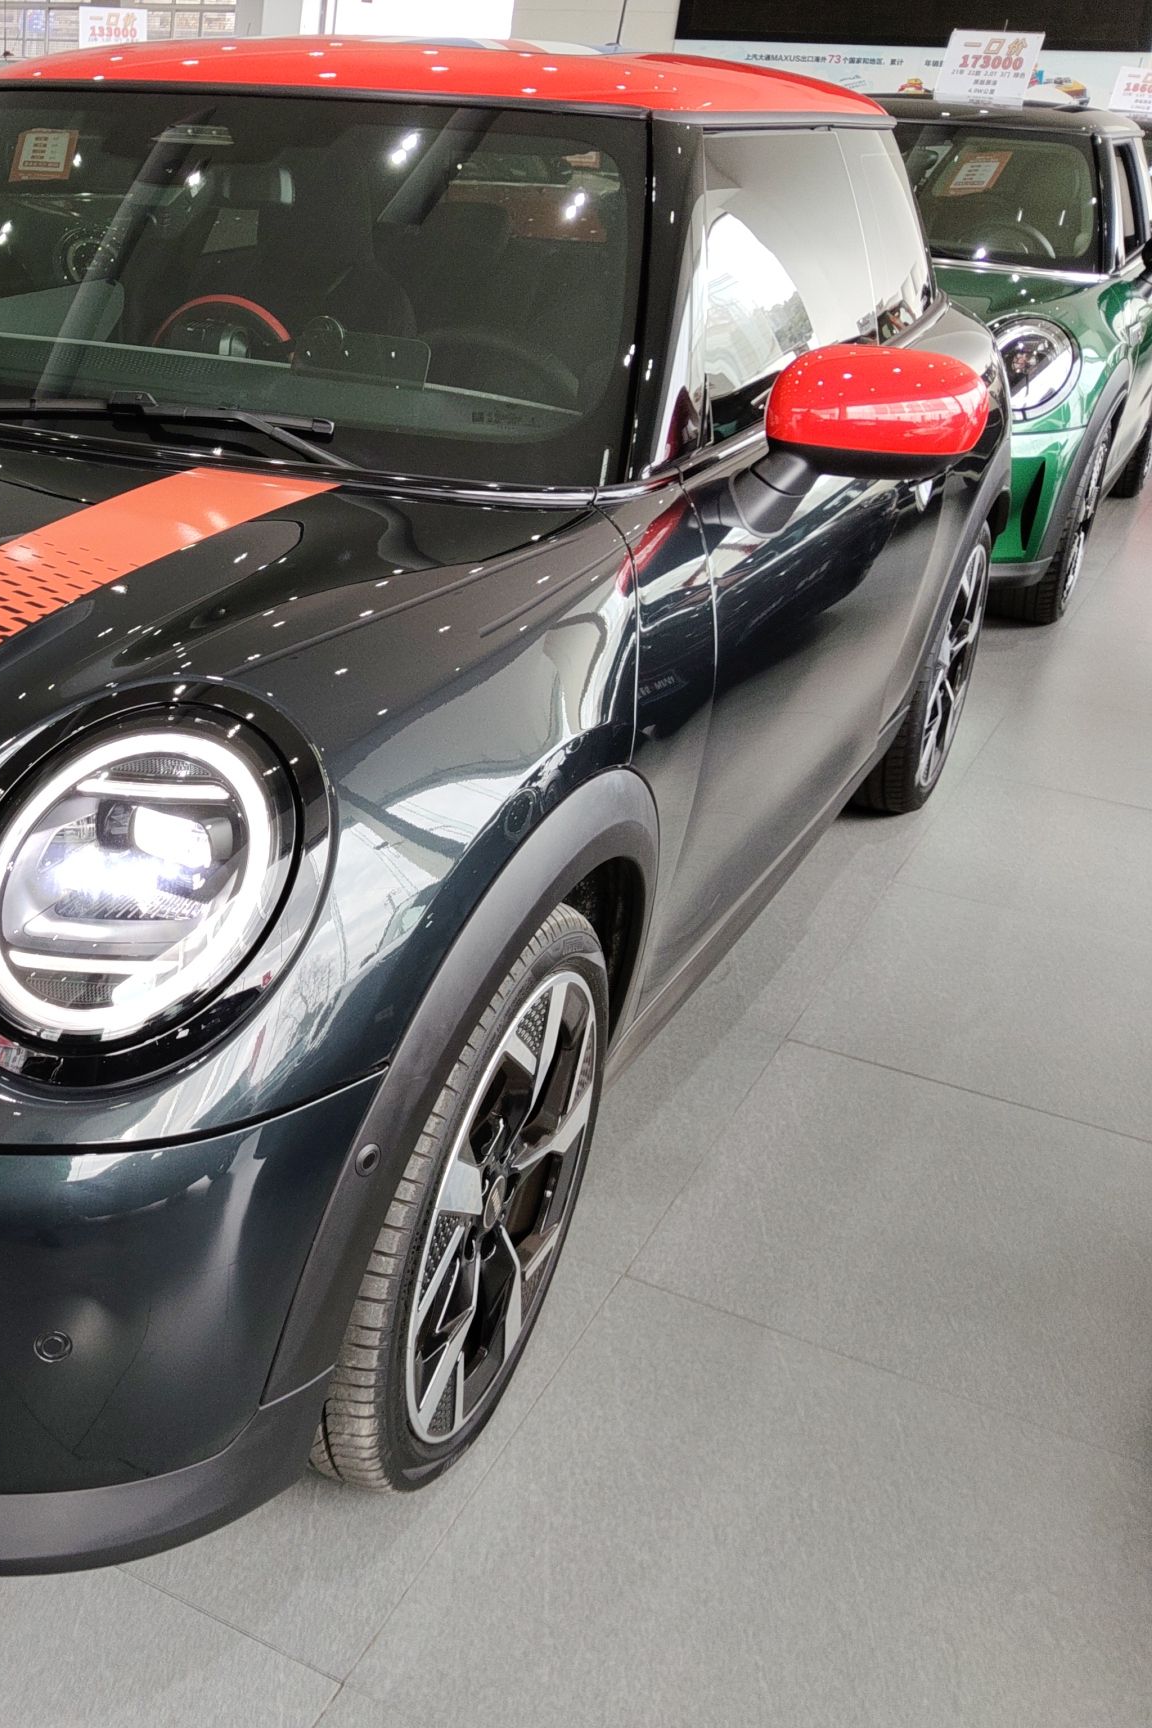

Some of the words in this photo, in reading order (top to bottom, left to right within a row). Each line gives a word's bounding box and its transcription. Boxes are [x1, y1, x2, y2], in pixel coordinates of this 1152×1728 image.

[964, 38, 1028, 56] 一口价
[959, 54, 1024, 70] 173000
